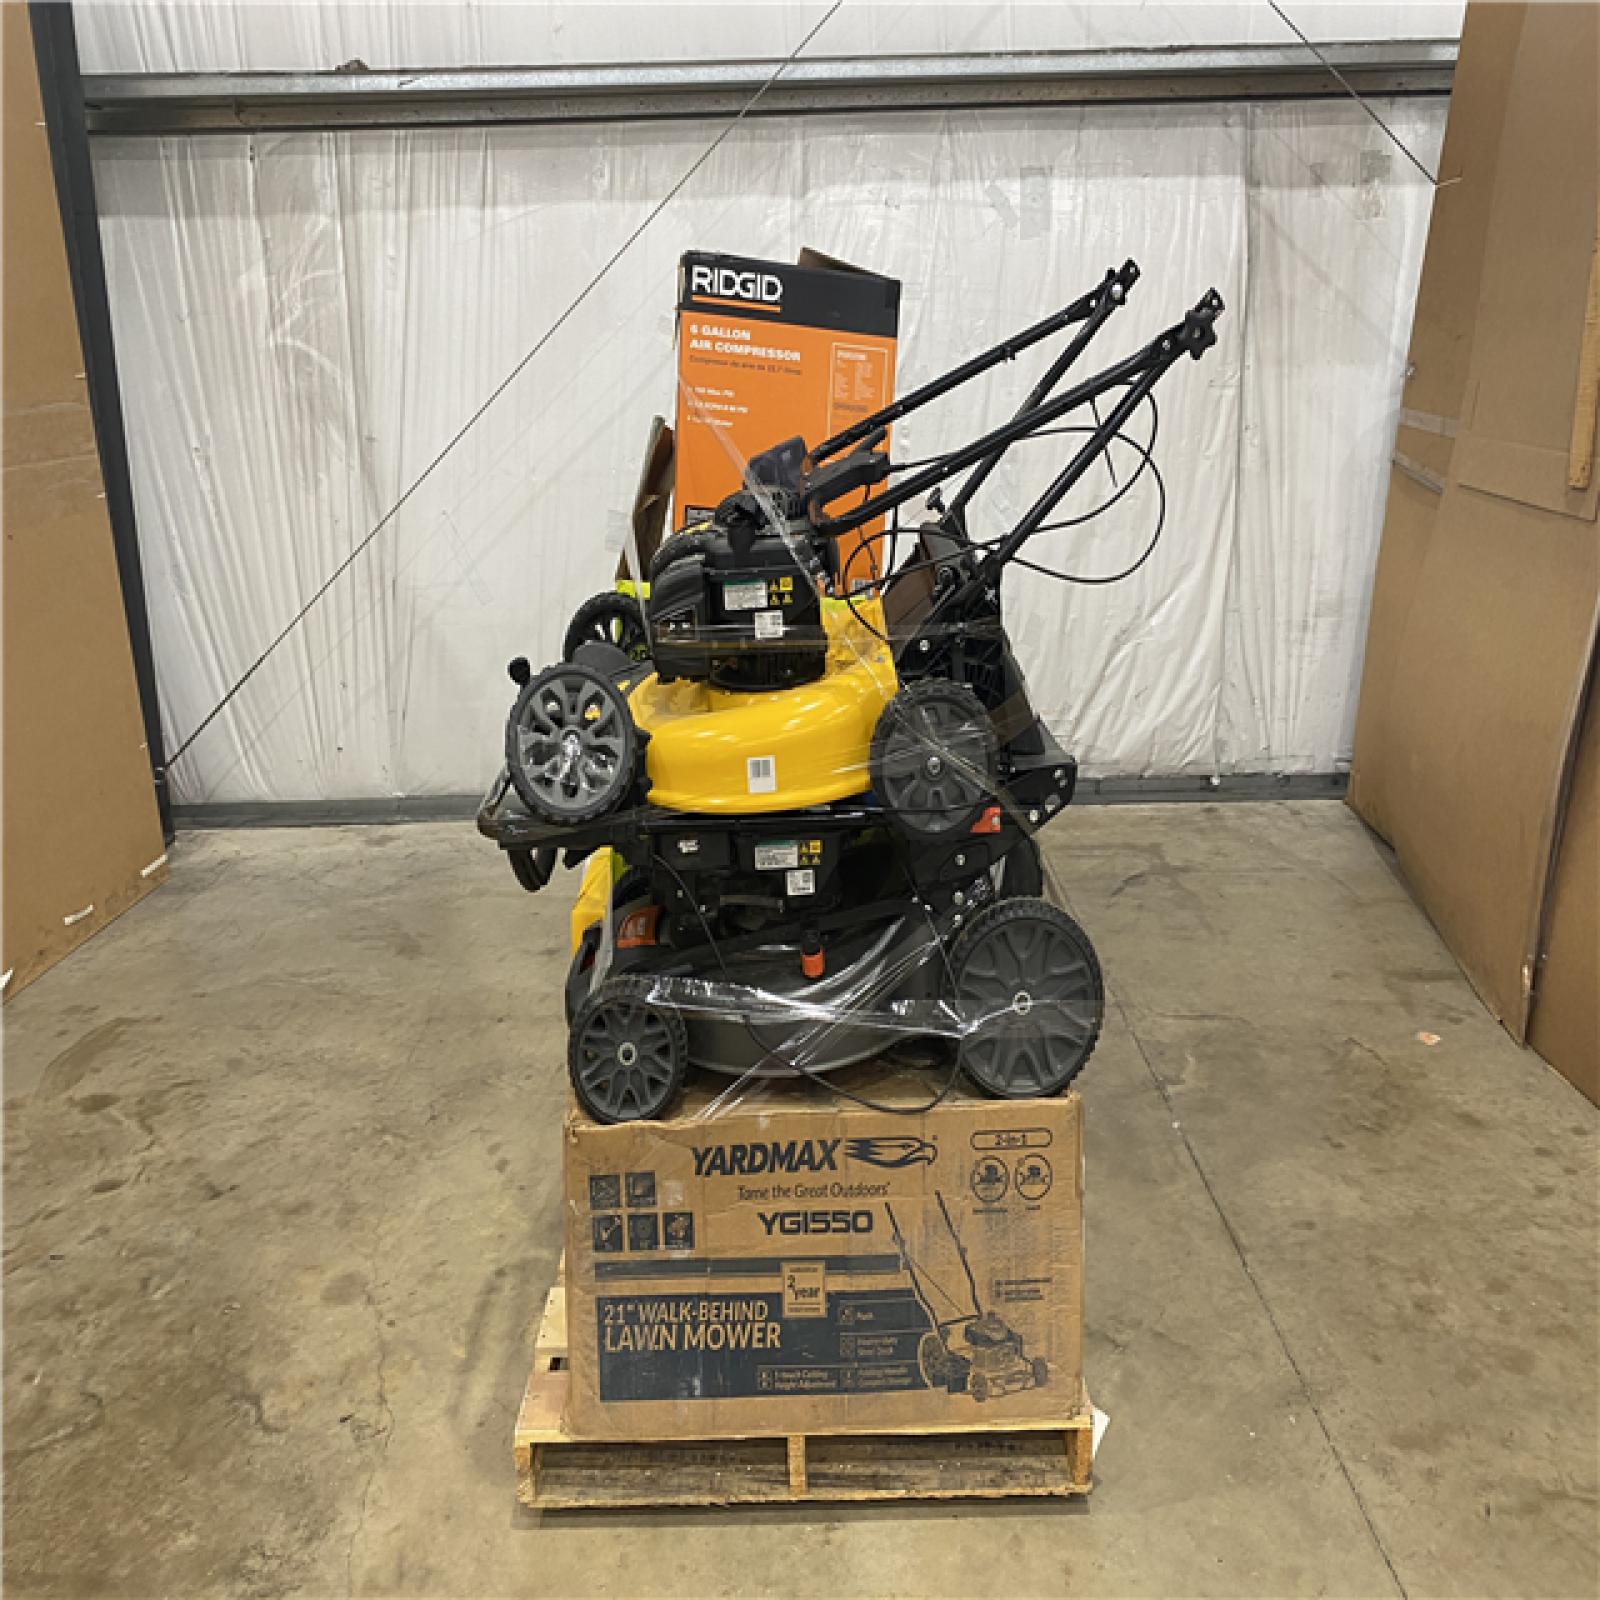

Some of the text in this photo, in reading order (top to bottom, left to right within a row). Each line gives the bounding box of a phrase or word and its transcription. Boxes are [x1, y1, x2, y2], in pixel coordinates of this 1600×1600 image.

[692, 264, 783, 301] RIDGID
[702, 324, 751, 341] GALLON
[690, 339, 801, 362] AIR COMPRESSOR
[690, 1138, 842, 1177] YARDMAX
[772, 1183, 793, 1199] the
[794, 1181, 828, 1198] Great
[638, 1299, 768, 1323] WALK-BEHIND
[604, 1321, 781, 1352] LAWN MOWER
